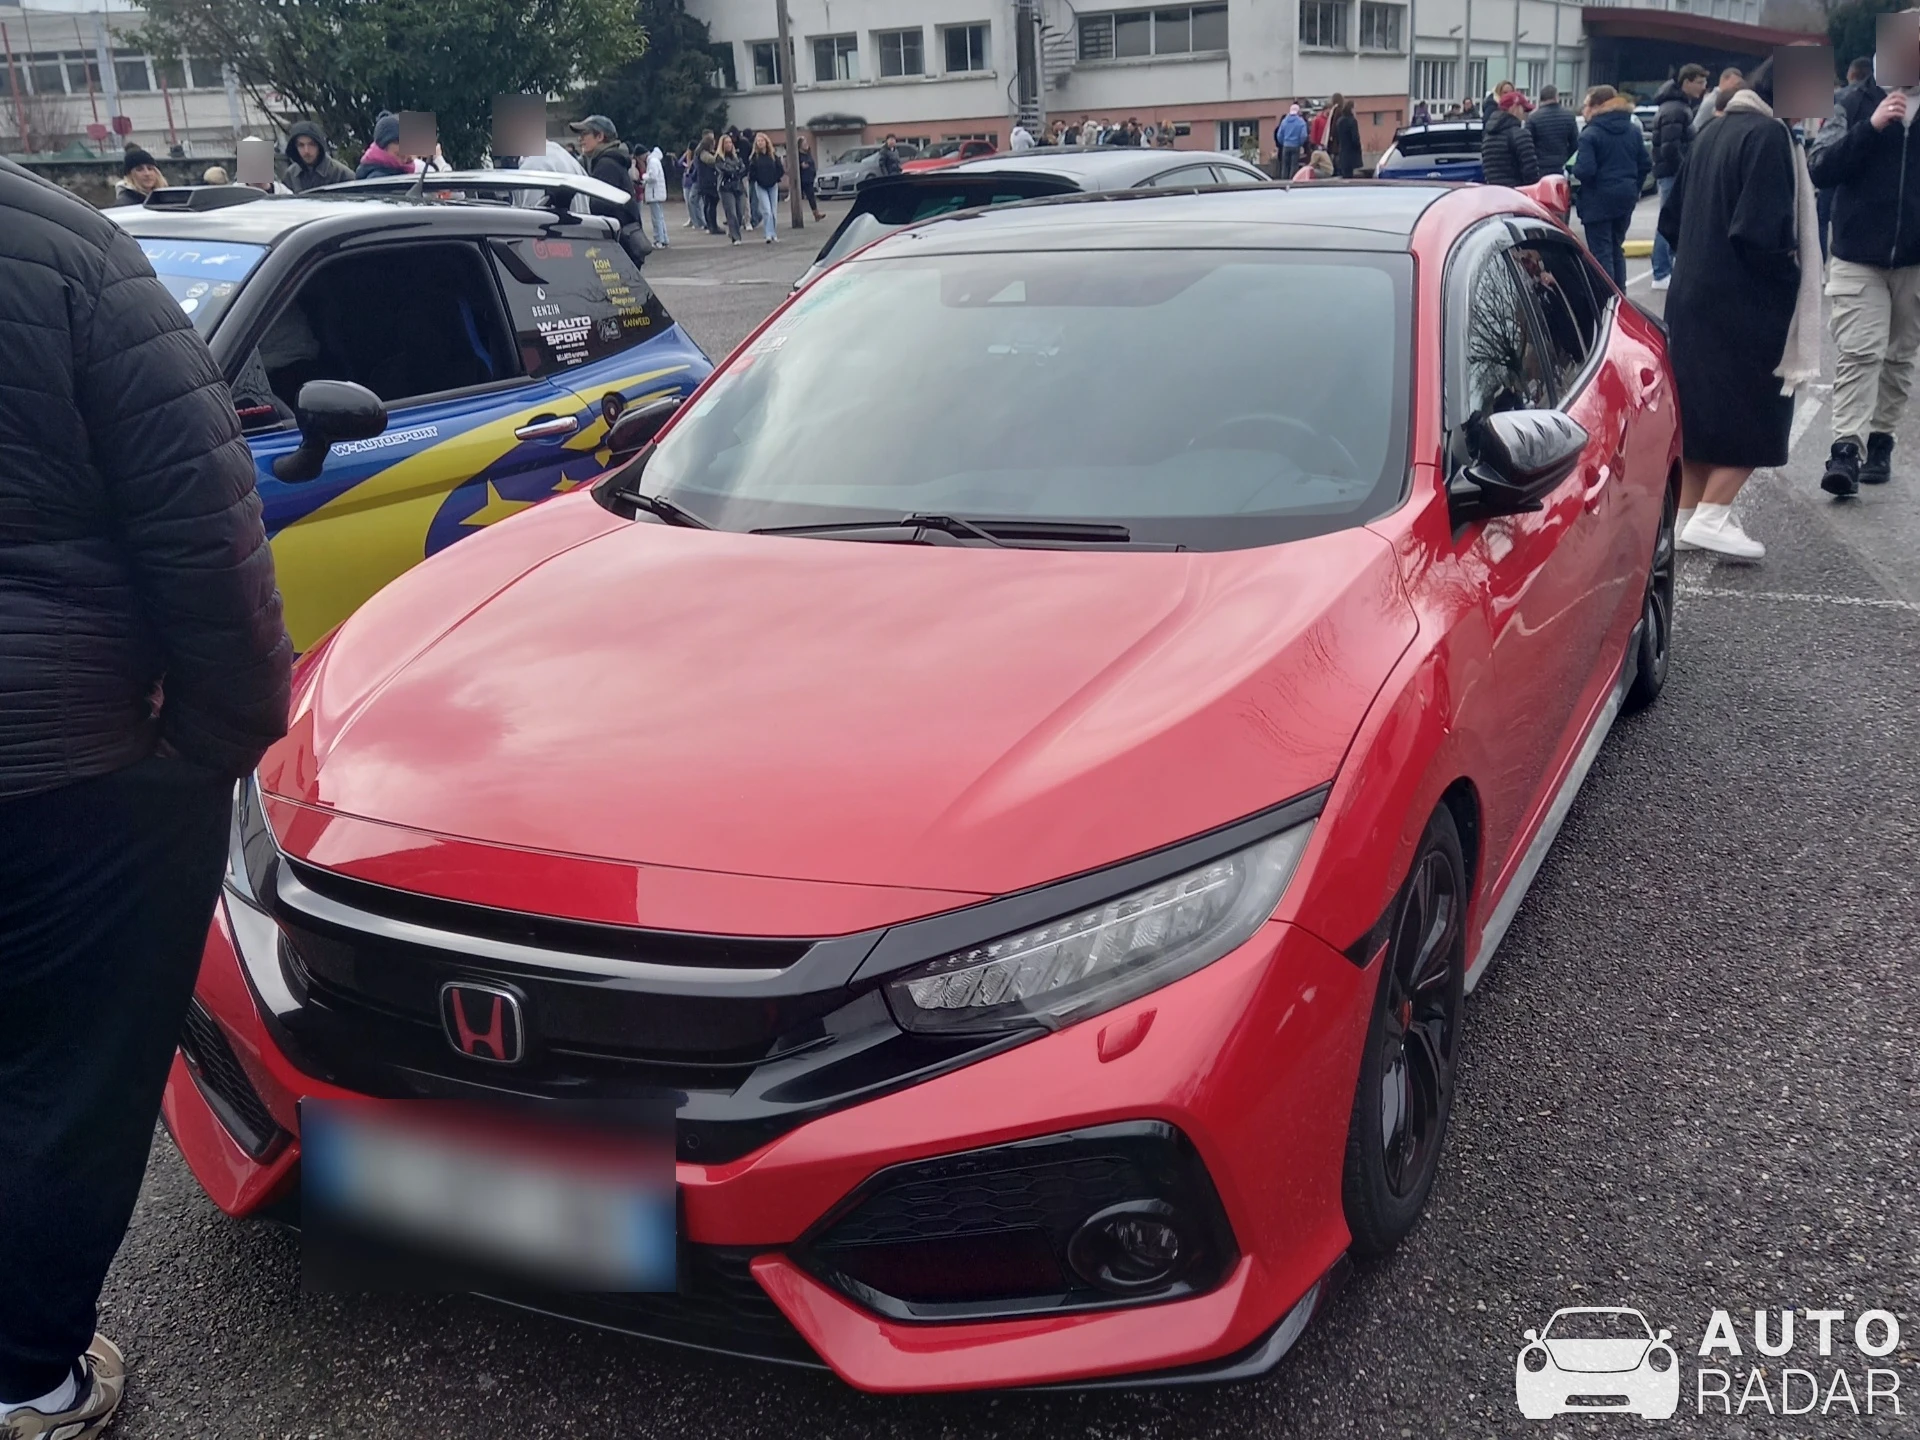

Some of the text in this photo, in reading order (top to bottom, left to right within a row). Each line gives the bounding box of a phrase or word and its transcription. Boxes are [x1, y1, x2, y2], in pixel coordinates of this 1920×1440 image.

[531, 304, 560, 317] BENZIN
[537, 316, 592, 332] W-AUTO
[546, 331, 589, 345] SPORT
[331, 425, 438, 457] W-AUTOSPORT
